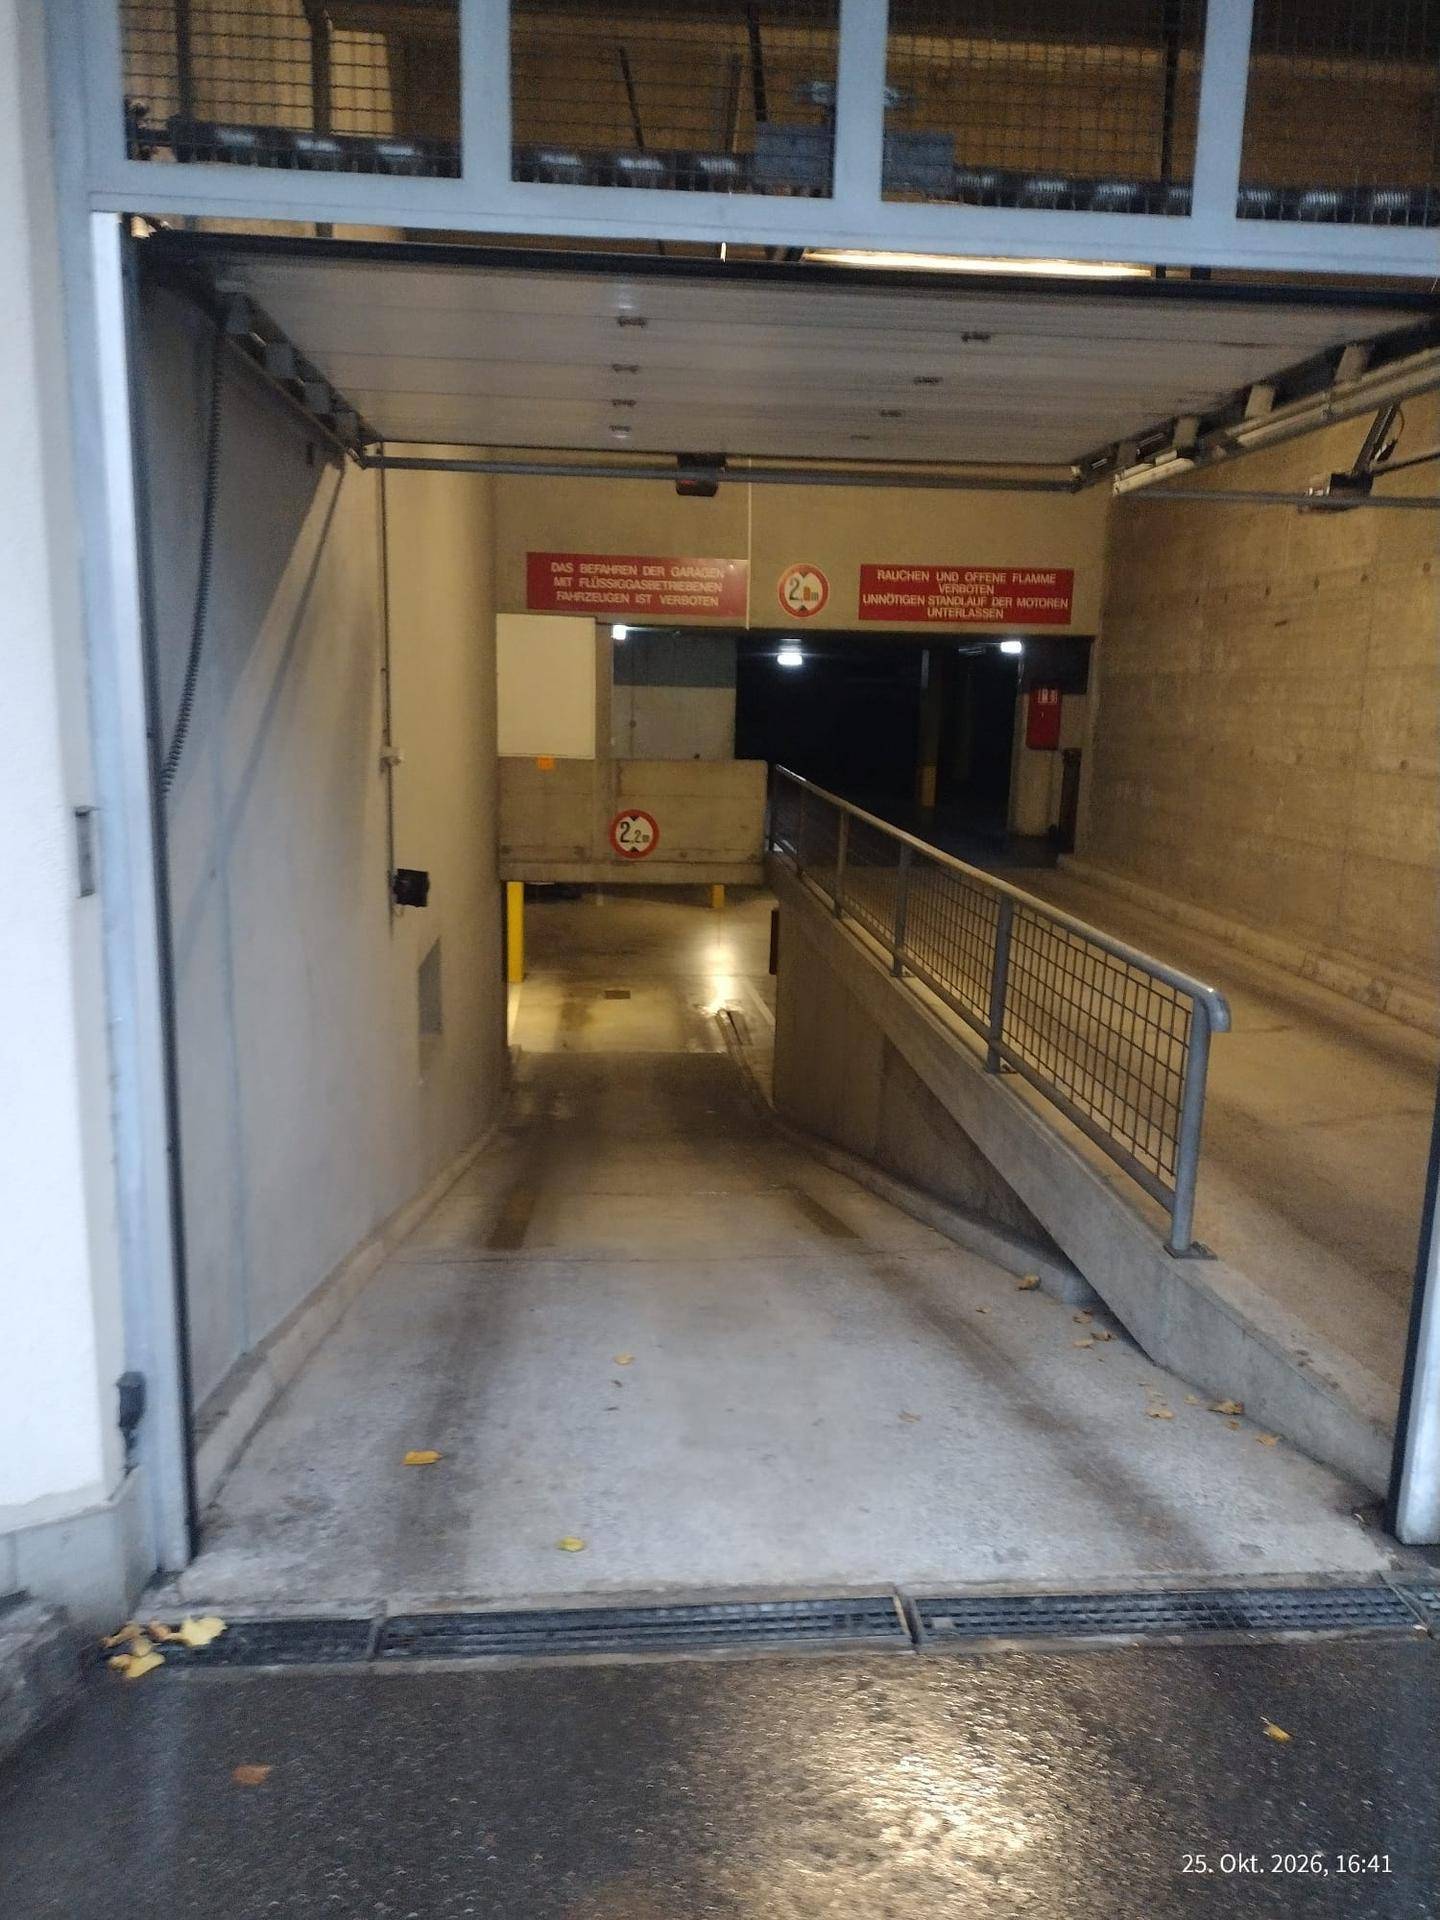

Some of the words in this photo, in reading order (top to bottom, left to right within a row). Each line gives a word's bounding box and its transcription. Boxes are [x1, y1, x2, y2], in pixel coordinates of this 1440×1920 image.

[551, 562, 574, 573] DAS
[580, 563, 637, 576] BEFAHREN
[642, 565, 665, 577] DER
[671, 566, 725, 578] GARAGEN
[877, 569, 929, 582] RAUCHEN
[936, 571, 960, 582] UND
[964, 572, 1007, 583] OFFENE
[1012, 572, 1057, 584] FLAMME
[553, 577, 572, 587] MIT
[579, 577, 723, 592] FLÜSSIGGASBETRIEBENEN
[938, 584, 995, 595] VERBOTEN
[557, 591, 629, 603] FAHRZEUGEN
[635, 593, 651, 604] IST
[660, 594, 719, 607] VERBOTEN
[862, 593, 925, 606] UNNÖTIGEN
[927, 595, 985, 607] STANDLAUF
[991, 597, 1013, 608] DER
[1016, 597, 1069, 609] MOTOREN
[927, 607, 1004, 619] UNTERLASSEN
